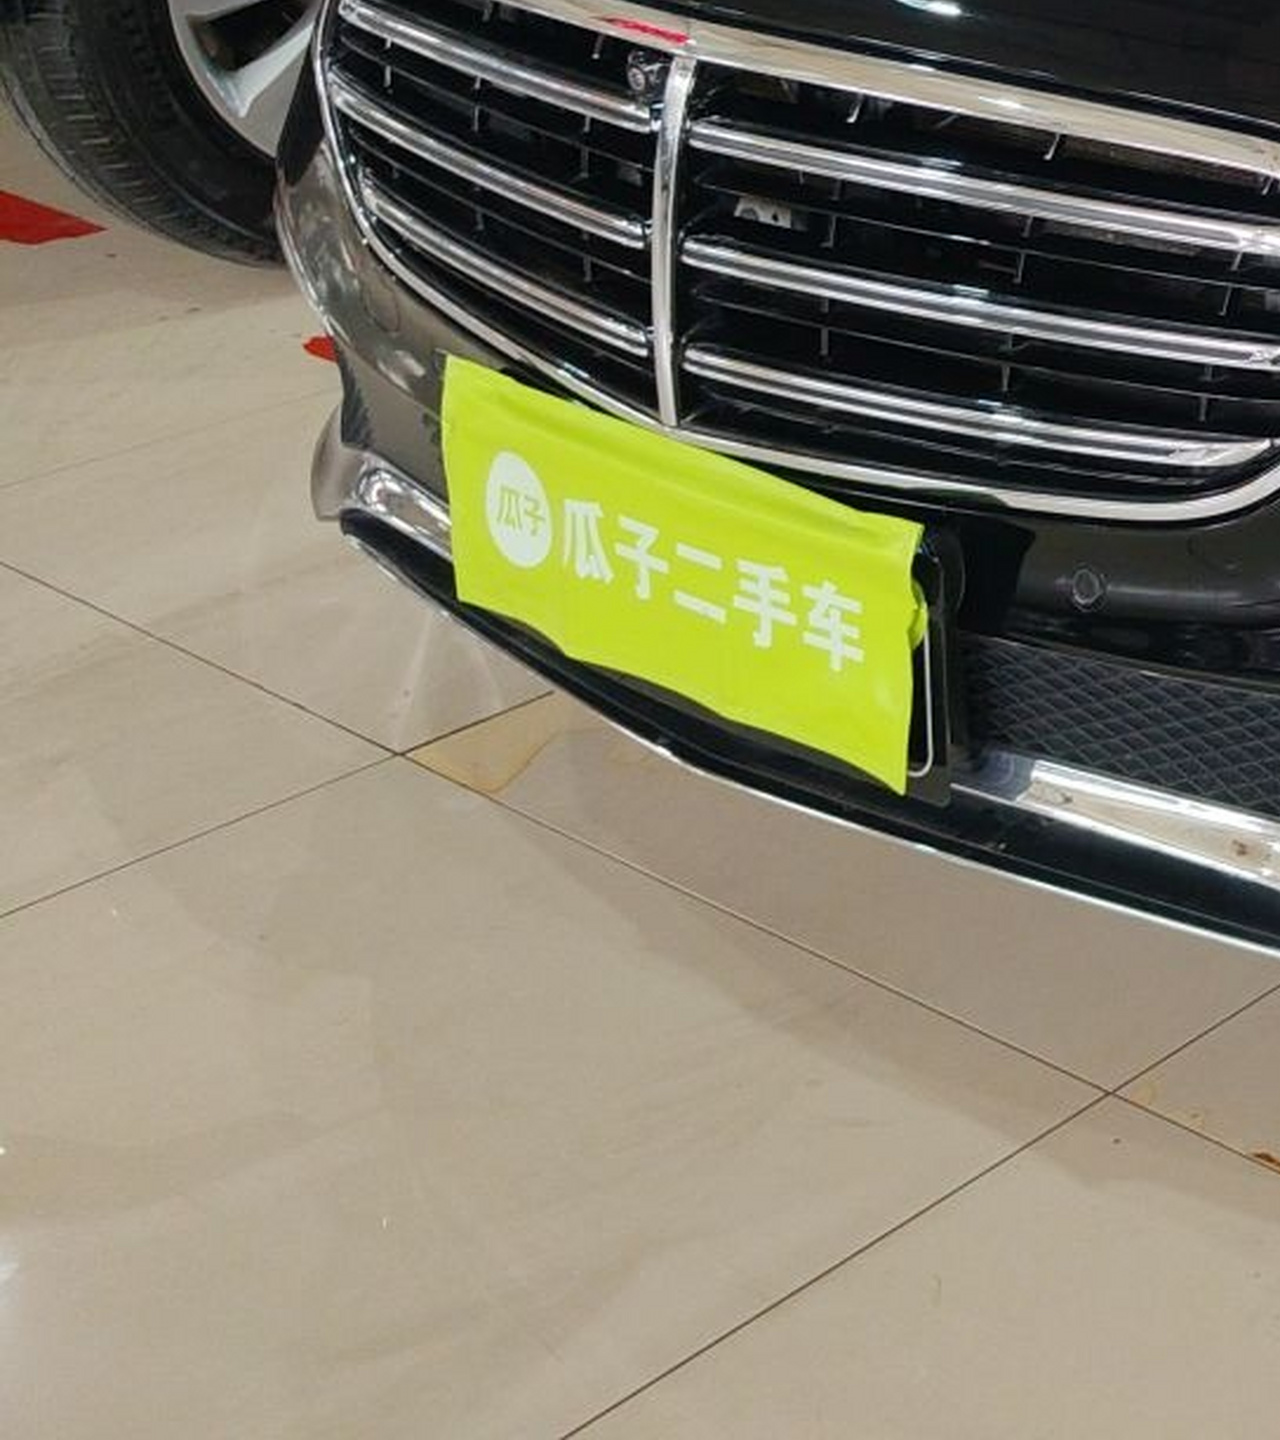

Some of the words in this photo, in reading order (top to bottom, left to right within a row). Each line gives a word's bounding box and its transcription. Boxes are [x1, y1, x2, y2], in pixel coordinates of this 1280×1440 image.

[496, 486, 546, 537] 瓜子
[563, 498, 864, 672] 瓜子二手车
